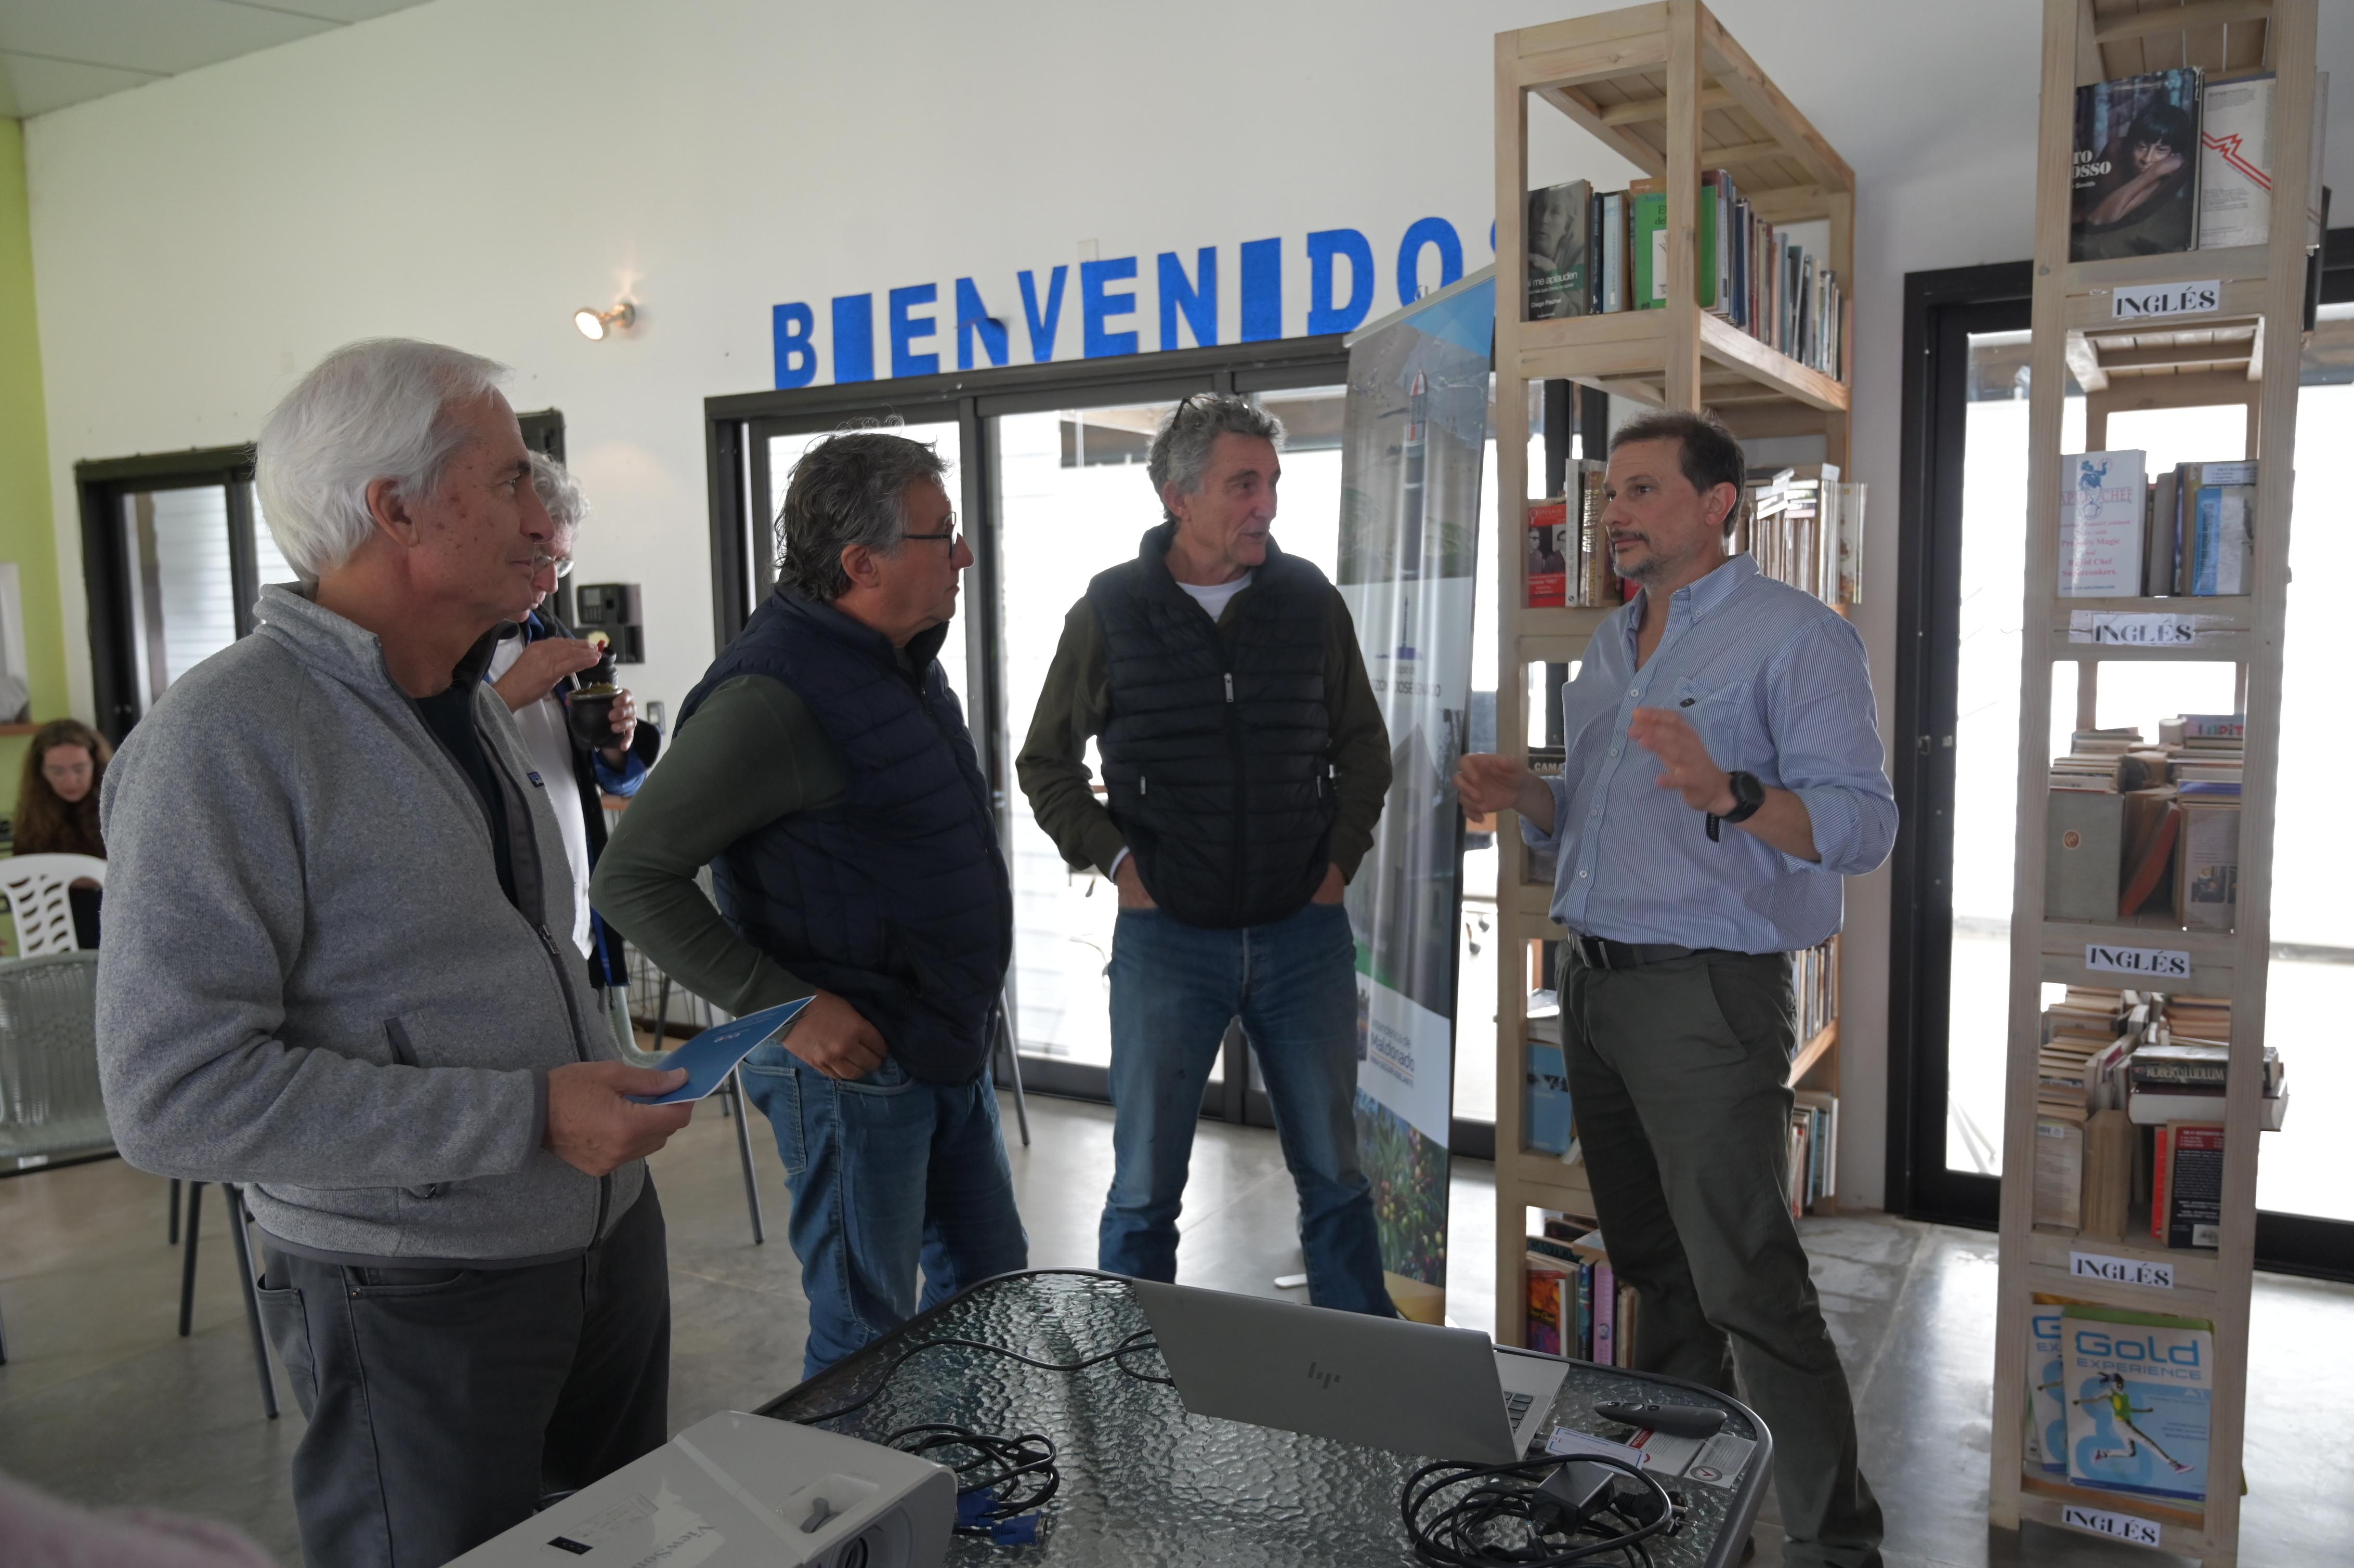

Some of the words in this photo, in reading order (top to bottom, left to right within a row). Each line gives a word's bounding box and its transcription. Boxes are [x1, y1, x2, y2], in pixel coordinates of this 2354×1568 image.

[1546, 271, 1577, 285] aplauden
[773, 216, 1495, 390] BIENVENIDO
[2116, 286, 2215, 315] INGLÉS
[2096, 619, 2191, 642] INGLÉS
[2091, 948, 2185, 974] INGLÉS
[1371, 1031, 1414, 1072] Maldonado
[2077, 1259, 2169, 1286] INGLÉS
[2075, 1331, 2200, 1366] Gold
[2077, 1357, 2202, 1380] EXPERIENCE
[2066, 1510, 2155, 1543] INGLÉS
